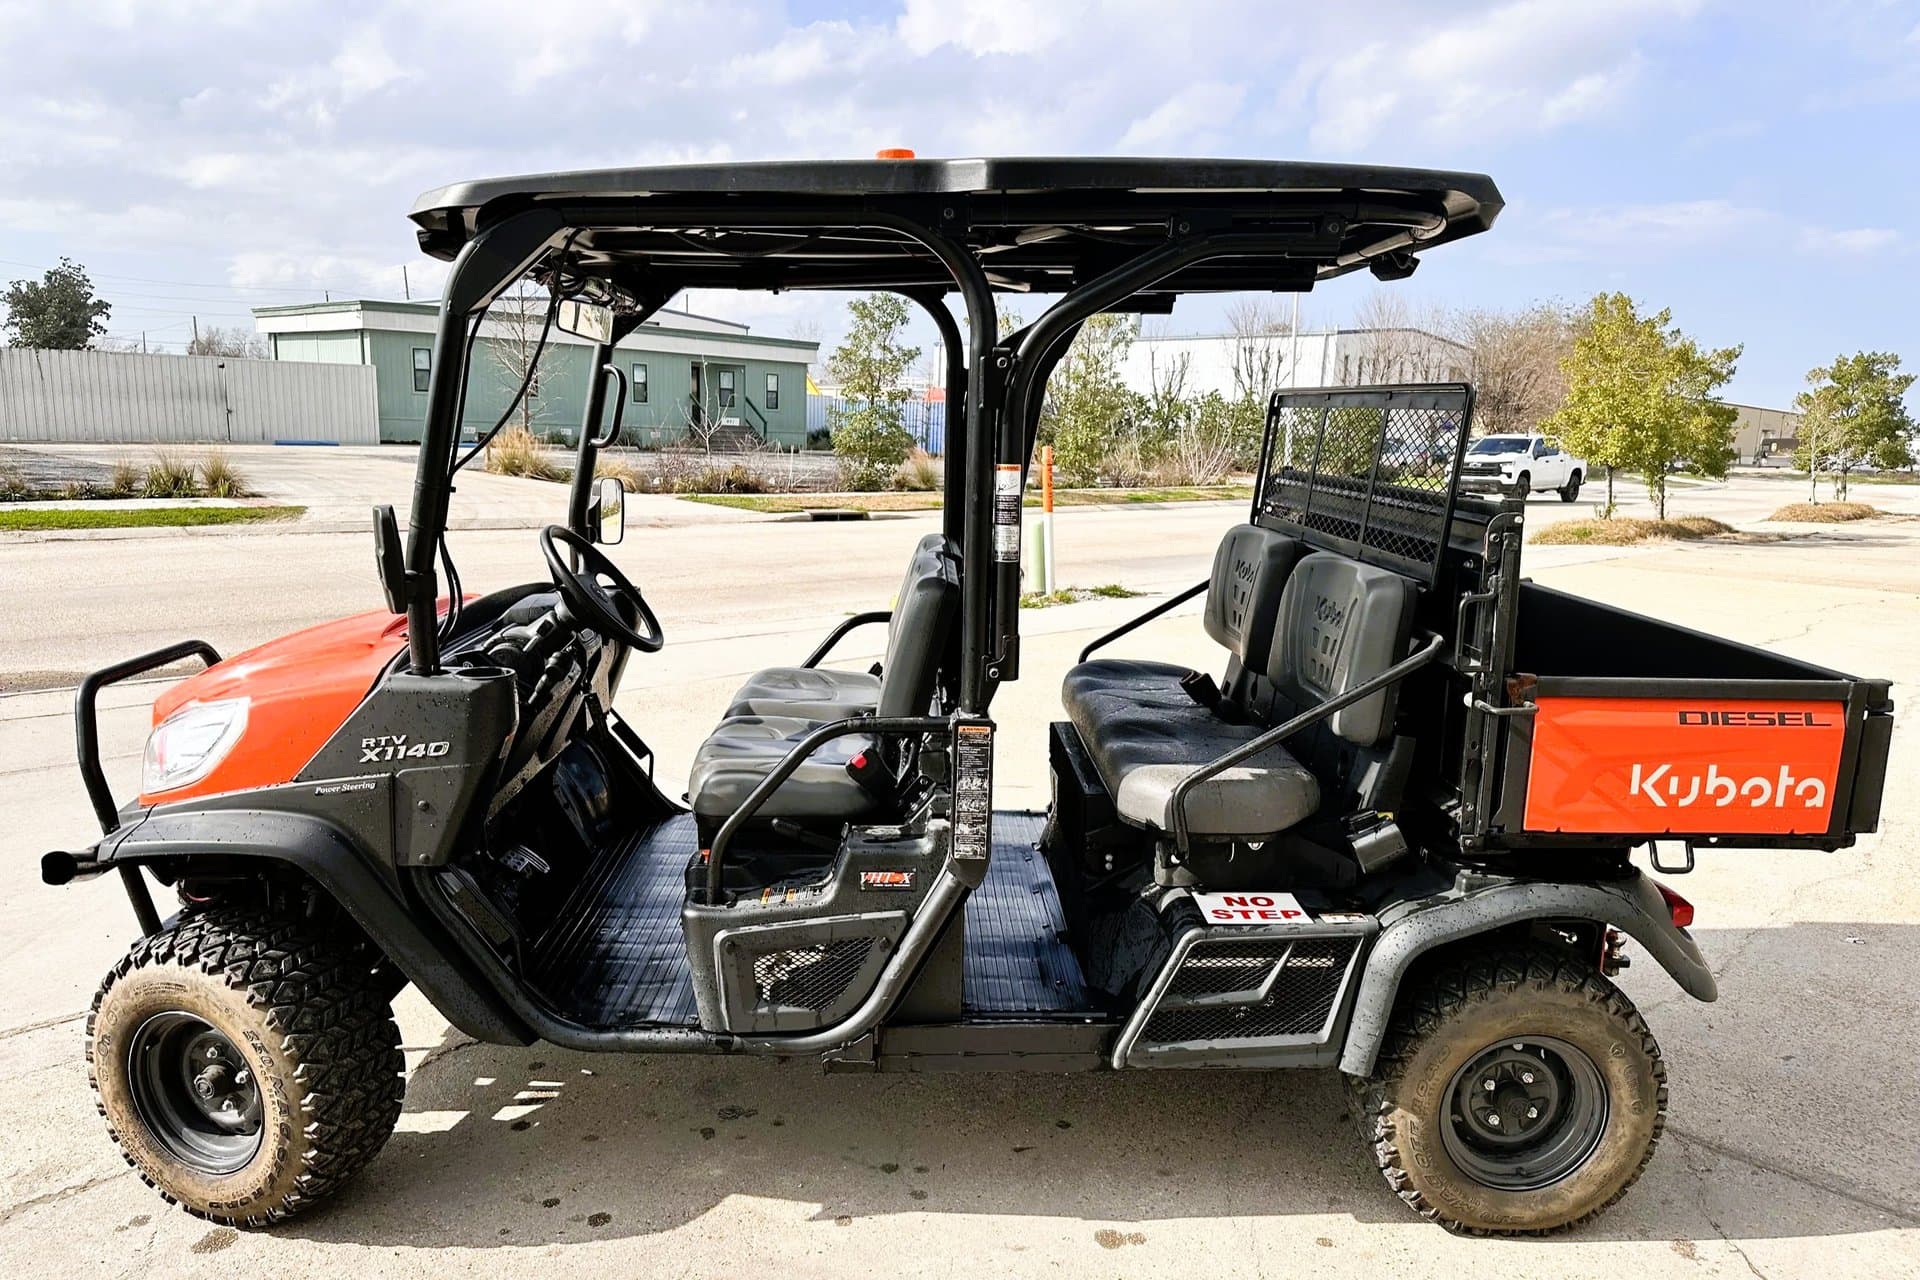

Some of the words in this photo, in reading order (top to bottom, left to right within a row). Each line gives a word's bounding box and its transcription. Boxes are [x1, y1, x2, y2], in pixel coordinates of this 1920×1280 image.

[1678, 711, 1832, 727] DIESEL
[361, 735, 407, 748] RTV
[359, 741, 450, 763] X1140
[315, 785, 341, 795] Power
[341, 781, 376, 793] Steering
[1630, 763, 1826, 808] Kubota
[1223, 896, 1275, 907] NO
[1211, 909, 1302, 920] STEP
